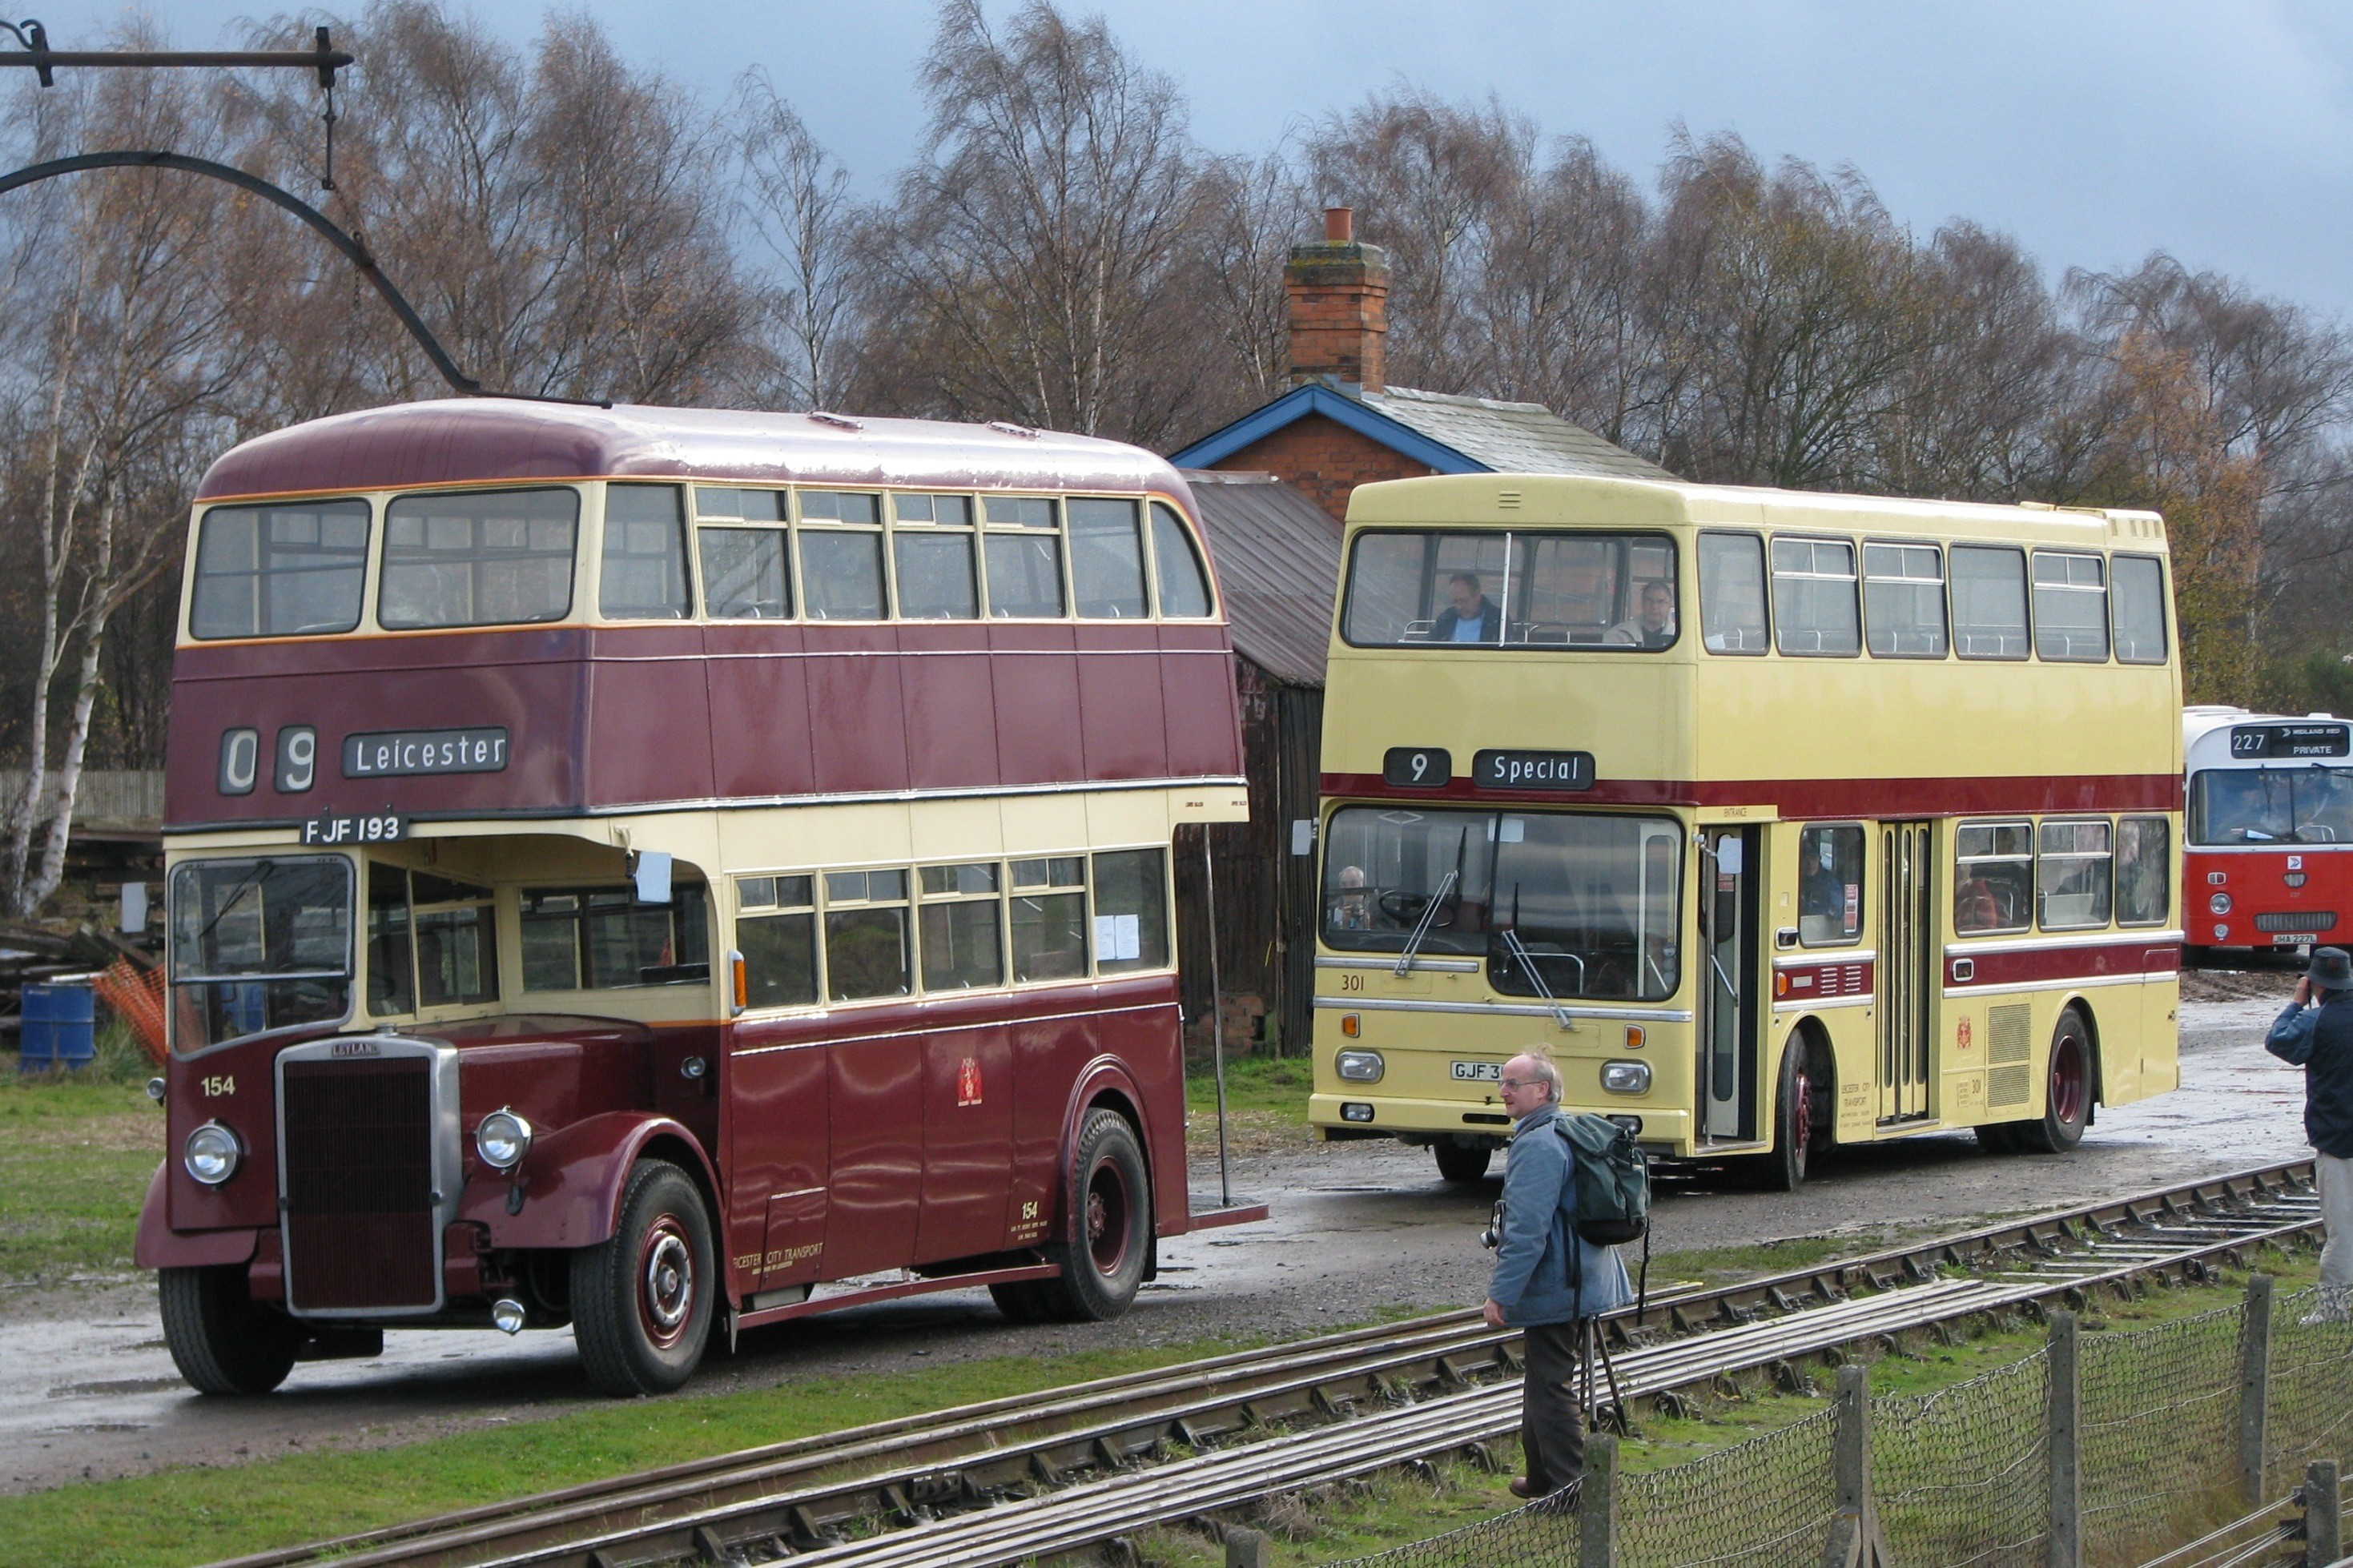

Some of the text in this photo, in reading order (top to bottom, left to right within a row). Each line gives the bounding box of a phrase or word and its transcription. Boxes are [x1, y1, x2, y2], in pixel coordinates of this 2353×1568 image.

[356, 734, 505, 772] Leicester
[2233, 734, 2265, 750] 227
[2293, 746, 2332, 754] PRIVATE
[1411, 753, 1428, 782] 9
[1494, 755, 1579, 783] Special
[306, 816, 399, 843] FJF 193
[1341, 975, 1364, 991] 301
[1455, 1063, 1486, 1078] GJF
[201, 1075, 235, 1097] 154
[1022, 1200, 1038, 1220] 154
[766, 1249, 783, 1264] CITY
[784, 1242, 823, 1260] TRANSPORT
